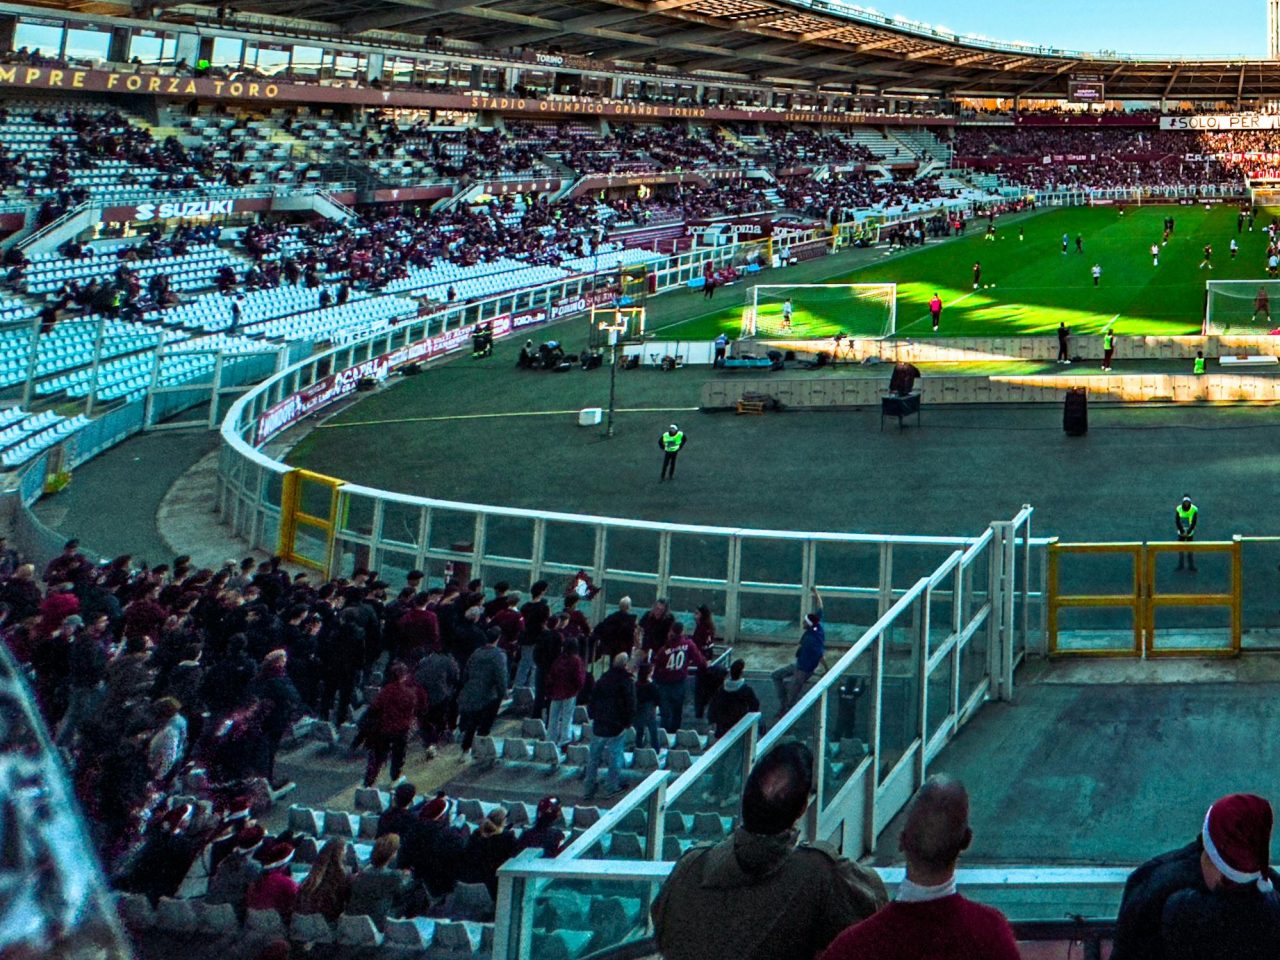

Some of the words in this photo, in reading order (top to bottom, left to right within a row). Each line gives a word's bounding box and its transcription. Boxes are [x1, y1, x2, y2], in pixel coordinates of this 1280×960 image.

[535, 53, 564, 65] TORINO
[107, 73, 197, 94] FORZA
[213, 80, 279, 98] TORO
[471, 96, 526, 110] STADIO
[540, 100, 603, 113] OLIMPICO
[615, 104, 659, 116] GRANDE
[668, 107, 706, 118] TORINO
[1179, 116, 1217, 129] SOLO
[1230, 116, 1260, 128] PER
[158, 199, 234, 218] SUZUKI
[665, 650, 686, 671] 40
